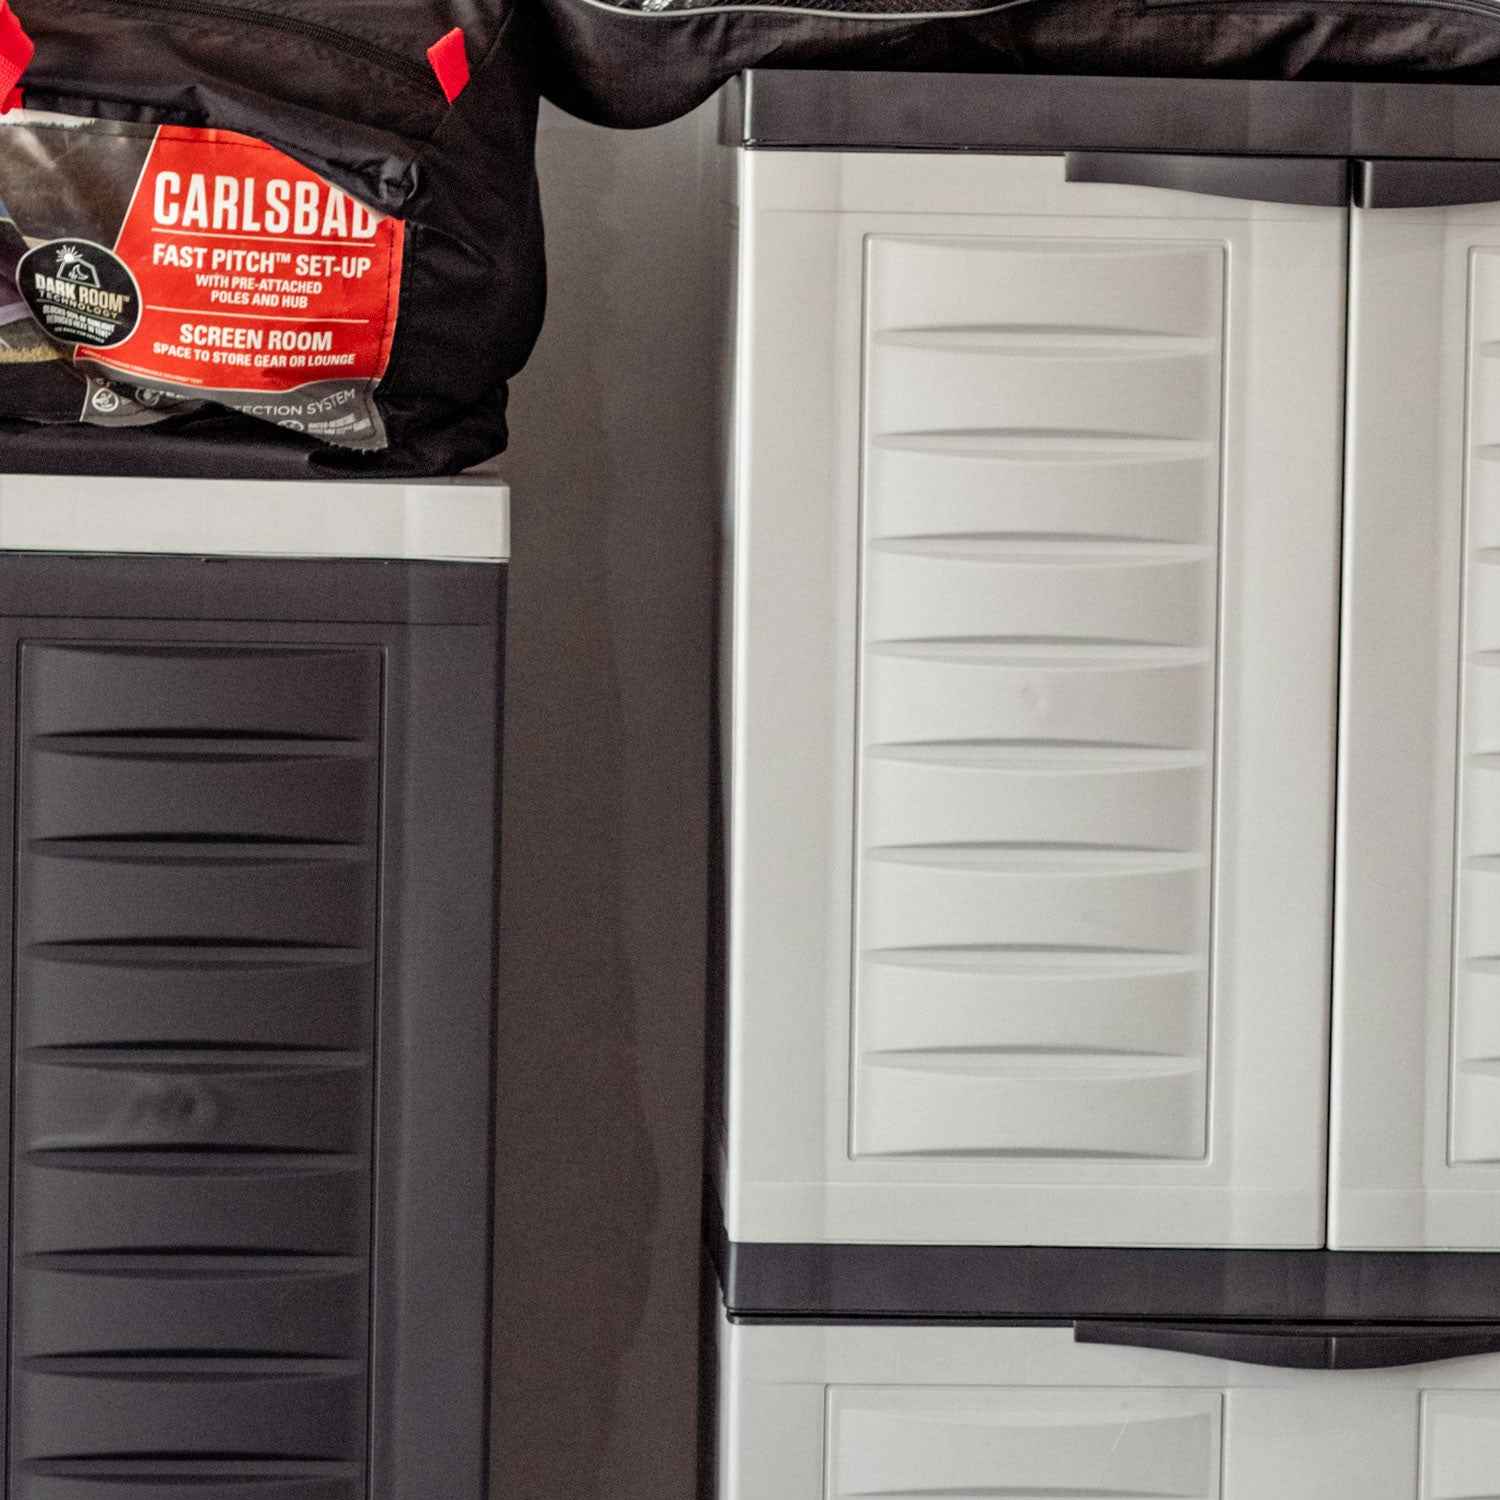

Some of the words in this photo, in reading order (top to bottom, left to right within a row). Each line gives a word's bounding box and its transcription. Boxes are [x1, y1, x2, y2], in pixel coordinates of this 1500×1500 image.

[153, 171, 378, 239] CARLSBAD
[152, 243, 207, 269] FAST
[296, 254, 371, 279] SET-UP
[35, 273, 77, 300] DARK
[195, 274, 230, 289] WITH
[231, 276, 322, 294] PRE-ATTACHED
[39, 290, 119, 319] TECHNOLOGY
[211, 290, 250, 305] POLES
[252, 293, 280, 307] AND
[281, 295, 309, 309] HUB
[179, 323, 264, 350] SCREEN
[268, 330, 333, 351] ROOM
[153, 342, 192, 360] SPACE
[194, 348, 210, 362] TO
[212, 350, 252, 367] STORE
[254, 353, 288, 368] GEAR
[289, 354, 305, 367] OR
[307, 353, 356, 367] LOUNGE
[233, 404, 303, 416] TECTION
[306, 388, 356, 415] SYSTEM
